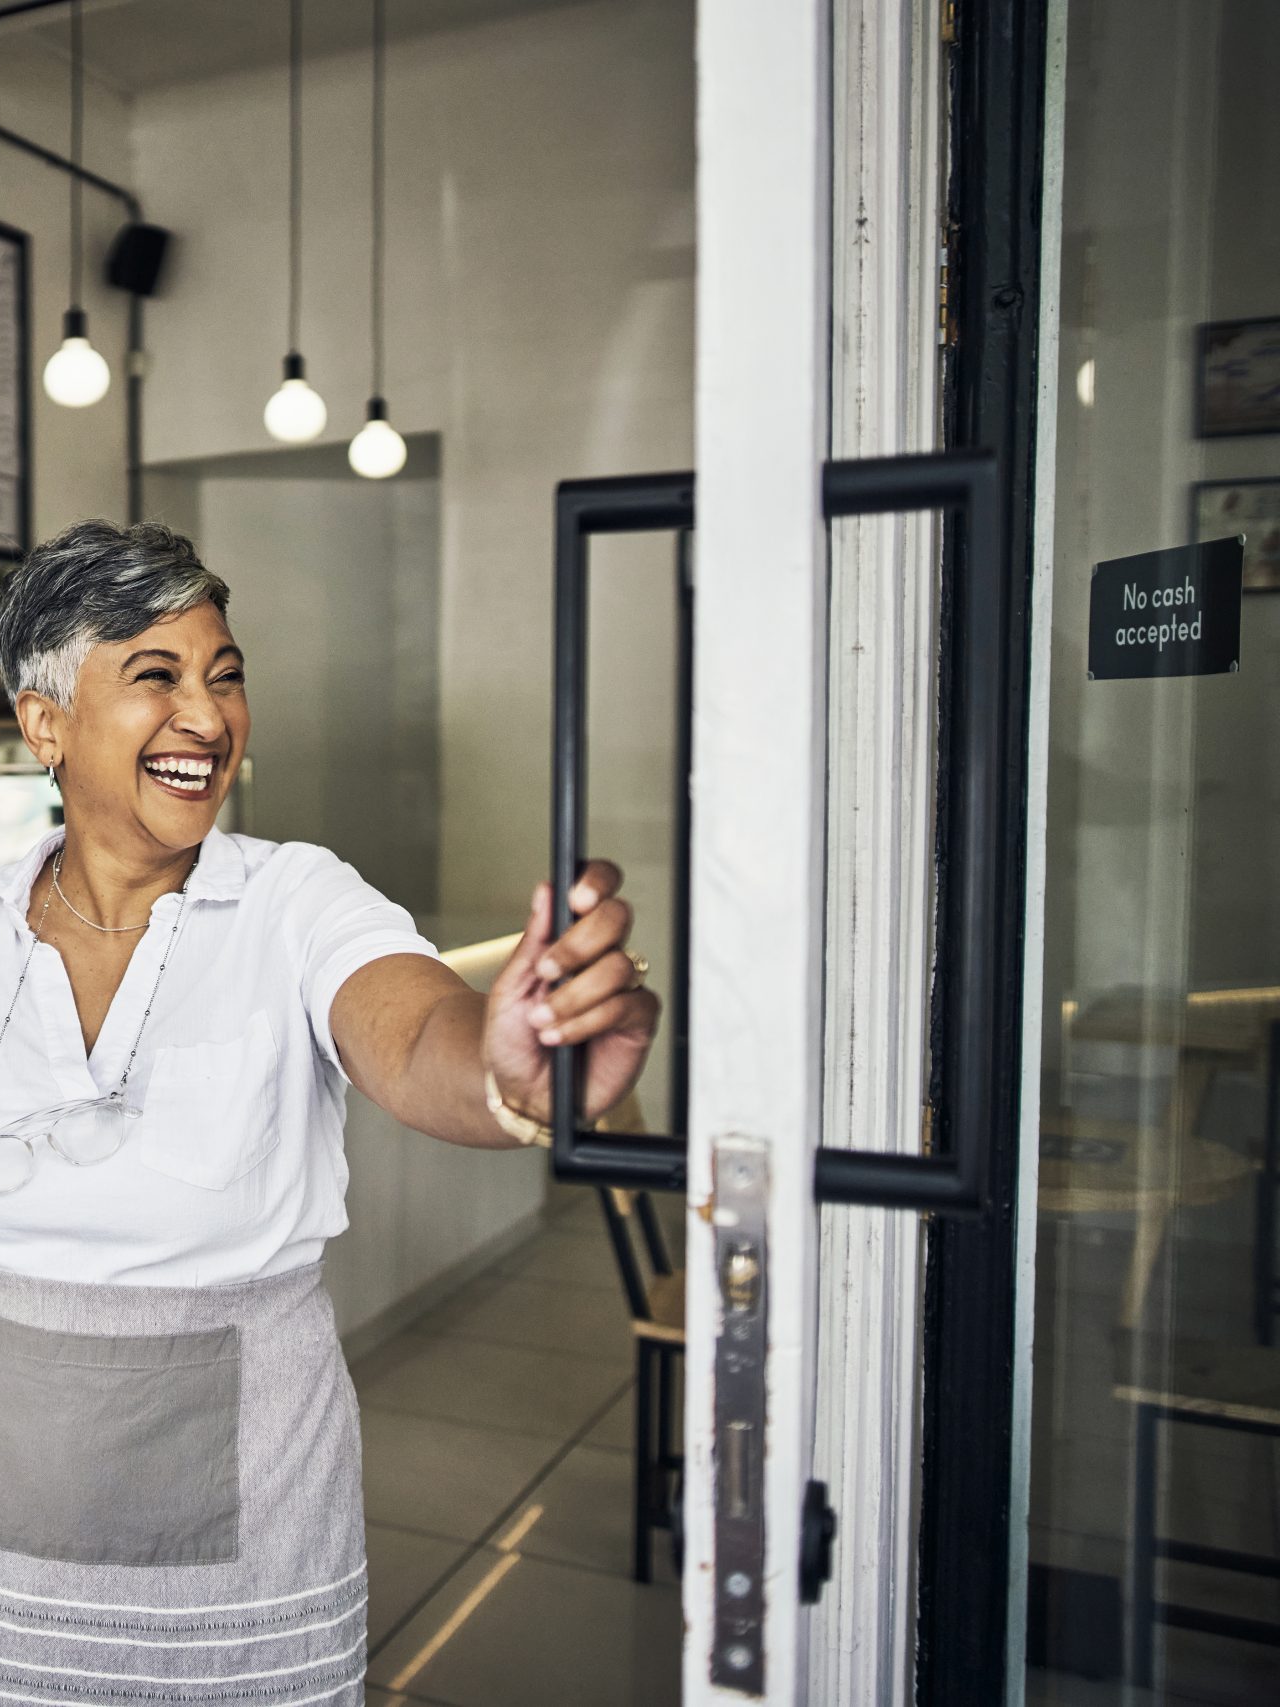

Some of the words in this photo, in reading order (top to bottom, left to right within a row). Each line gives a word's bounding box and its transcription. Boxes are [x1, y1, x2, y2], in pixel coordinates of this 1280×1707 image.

[1123, 582, 1148, 611] No
[1151, 575, 1195, 608] cash
[1115, 610, 1202, 652] accepted
